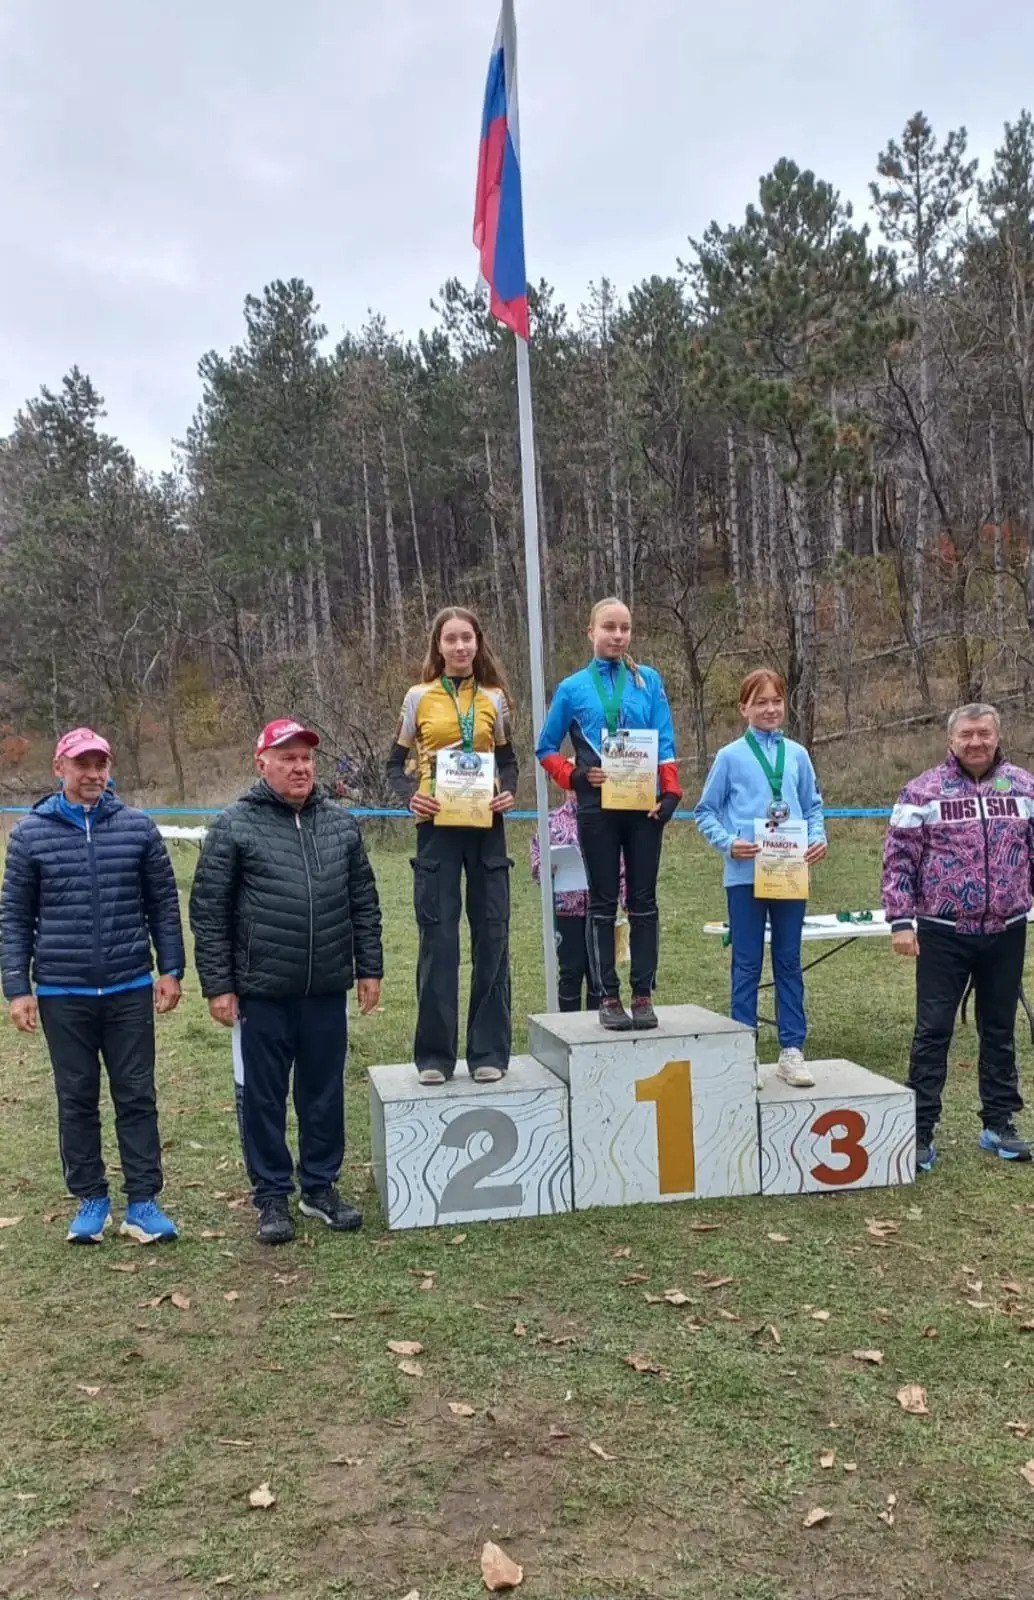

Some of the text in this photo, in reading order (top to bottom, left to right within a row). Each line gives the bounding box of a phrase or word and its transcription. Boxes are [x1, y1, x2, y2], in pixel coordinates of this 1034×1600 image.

[763, 840, 798, 849] ГРАМОТА
[438, 1109, 523, 1212] 2
[635, 1060, 695, 1194] 1
[810, 1109, 869, 1186] 3
